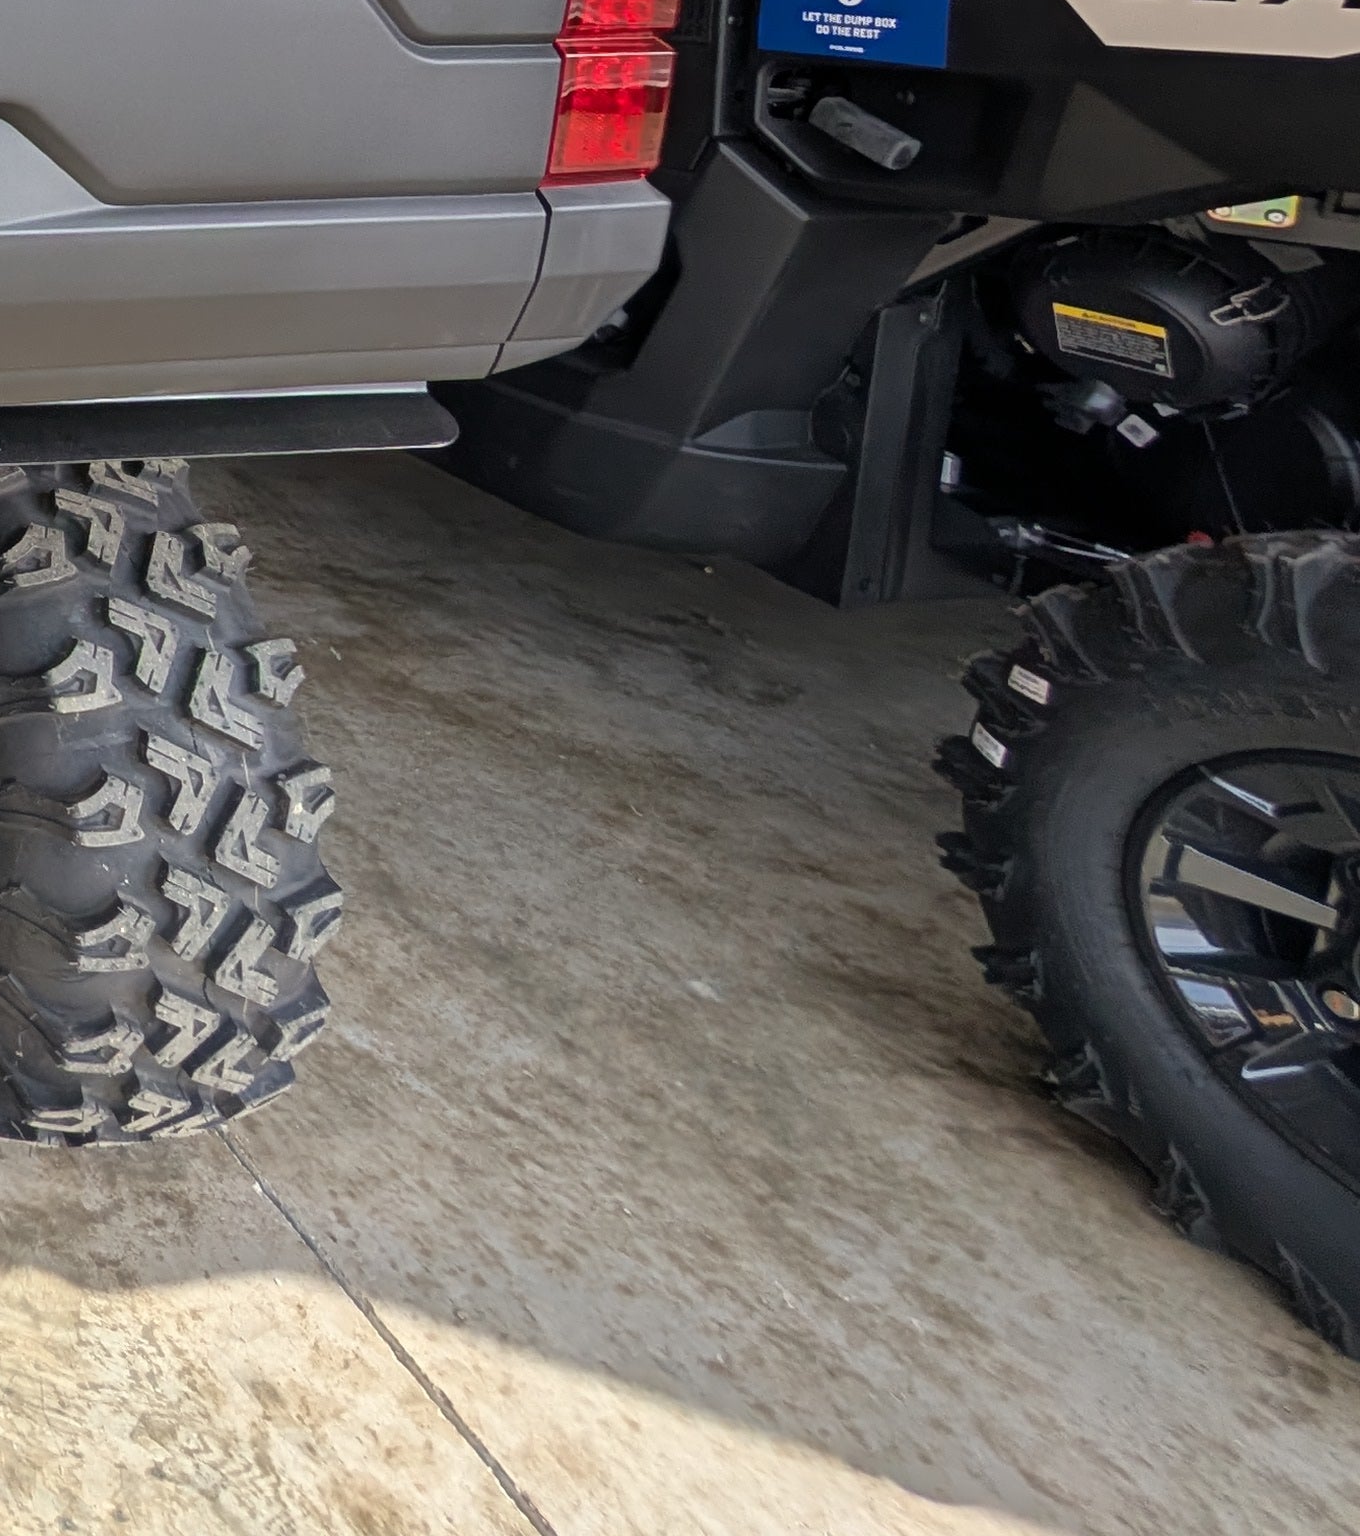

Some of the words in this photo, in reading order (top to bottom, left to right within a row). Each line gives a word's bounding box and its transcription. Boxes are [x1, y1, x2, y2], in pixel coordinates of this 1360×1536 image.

[802, 11, 822, 22] LET
[823, 13, 842, 24] THE
[844, 15, 873, 27] DUMP
[874, 17, 897, 29] BOX
[815, 25, 830, 35] DO
[832, 26, 851, 38] THE
[853, 28, 881, 40] REST
